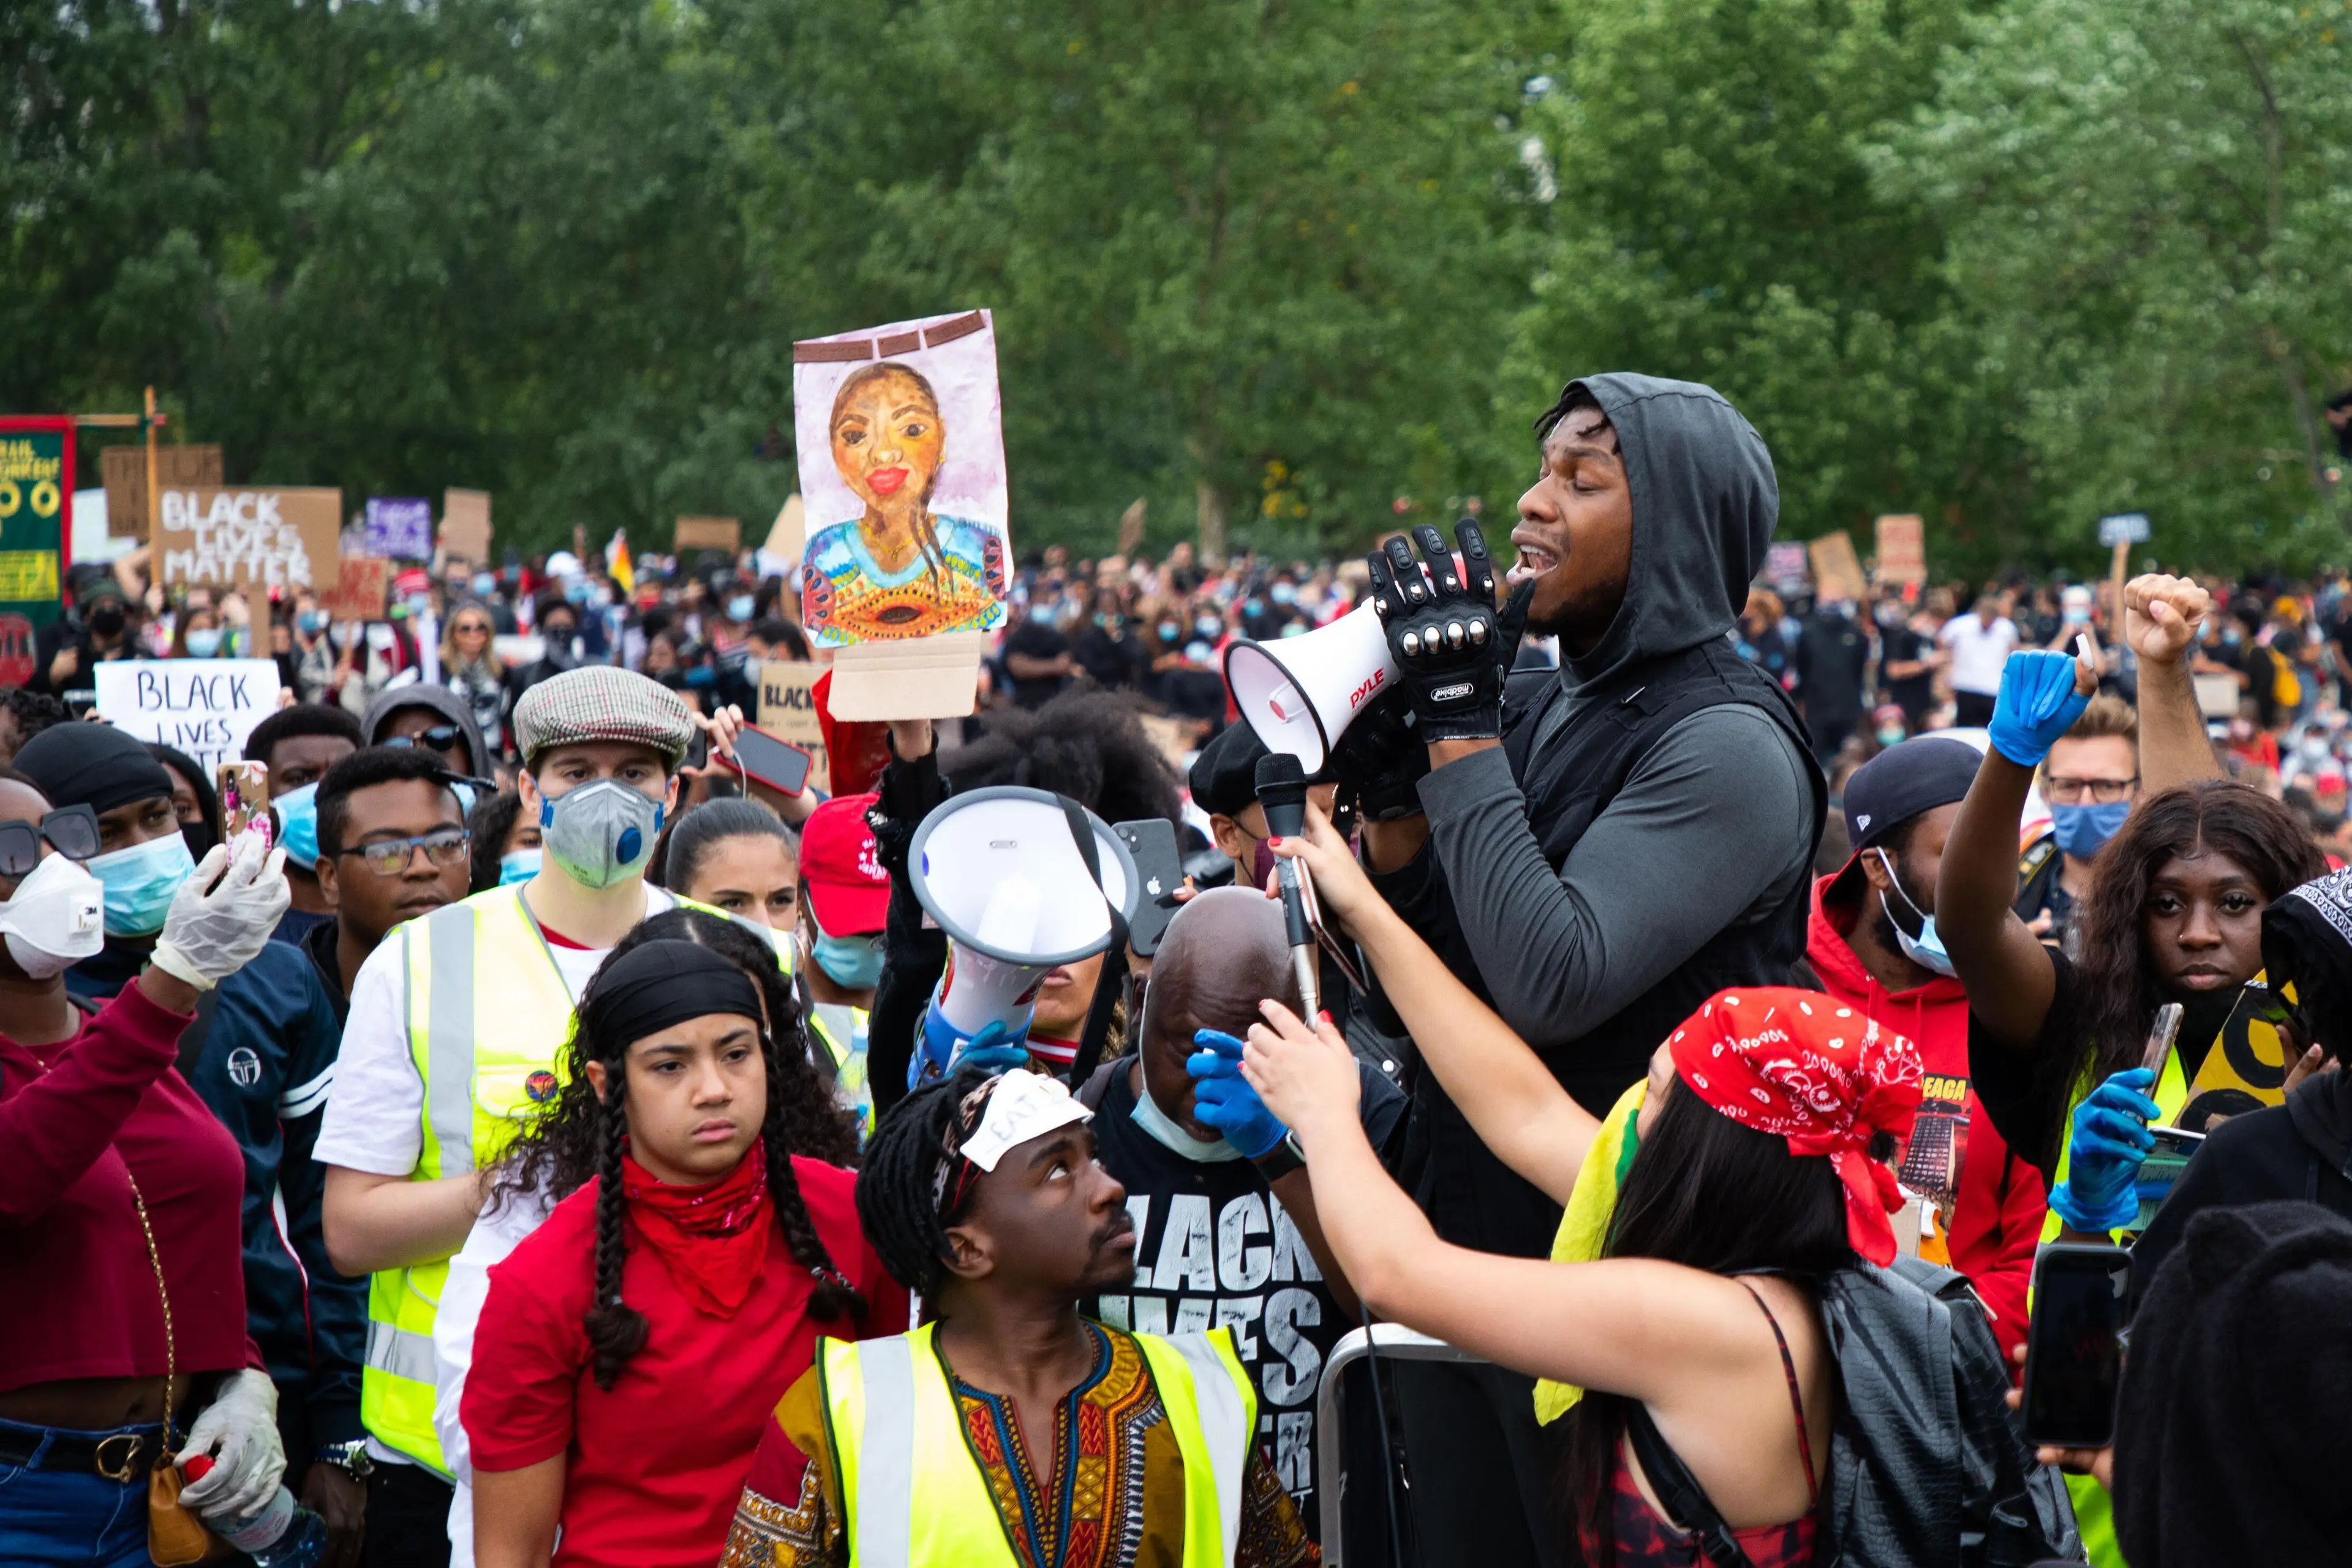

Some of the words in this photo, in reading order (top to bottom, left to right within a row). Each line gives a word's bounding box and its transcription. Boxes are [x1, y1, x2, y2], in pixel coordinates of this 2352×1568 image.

[161, 491, 283, 531] BLACK
[194, 523, 304, 559] LIVES
[164, 549, 312, 586] MATTER
[137, 670, 252, 712] BLACK
[1349, 667, 1385, 709] PYLE
[1435, 684, 1469, 698] madbike
[157, 718, 232, 746] LIVES
[85, 907, 97, 915] 3M
[1125, 1191, 1323, 1291] LACK
